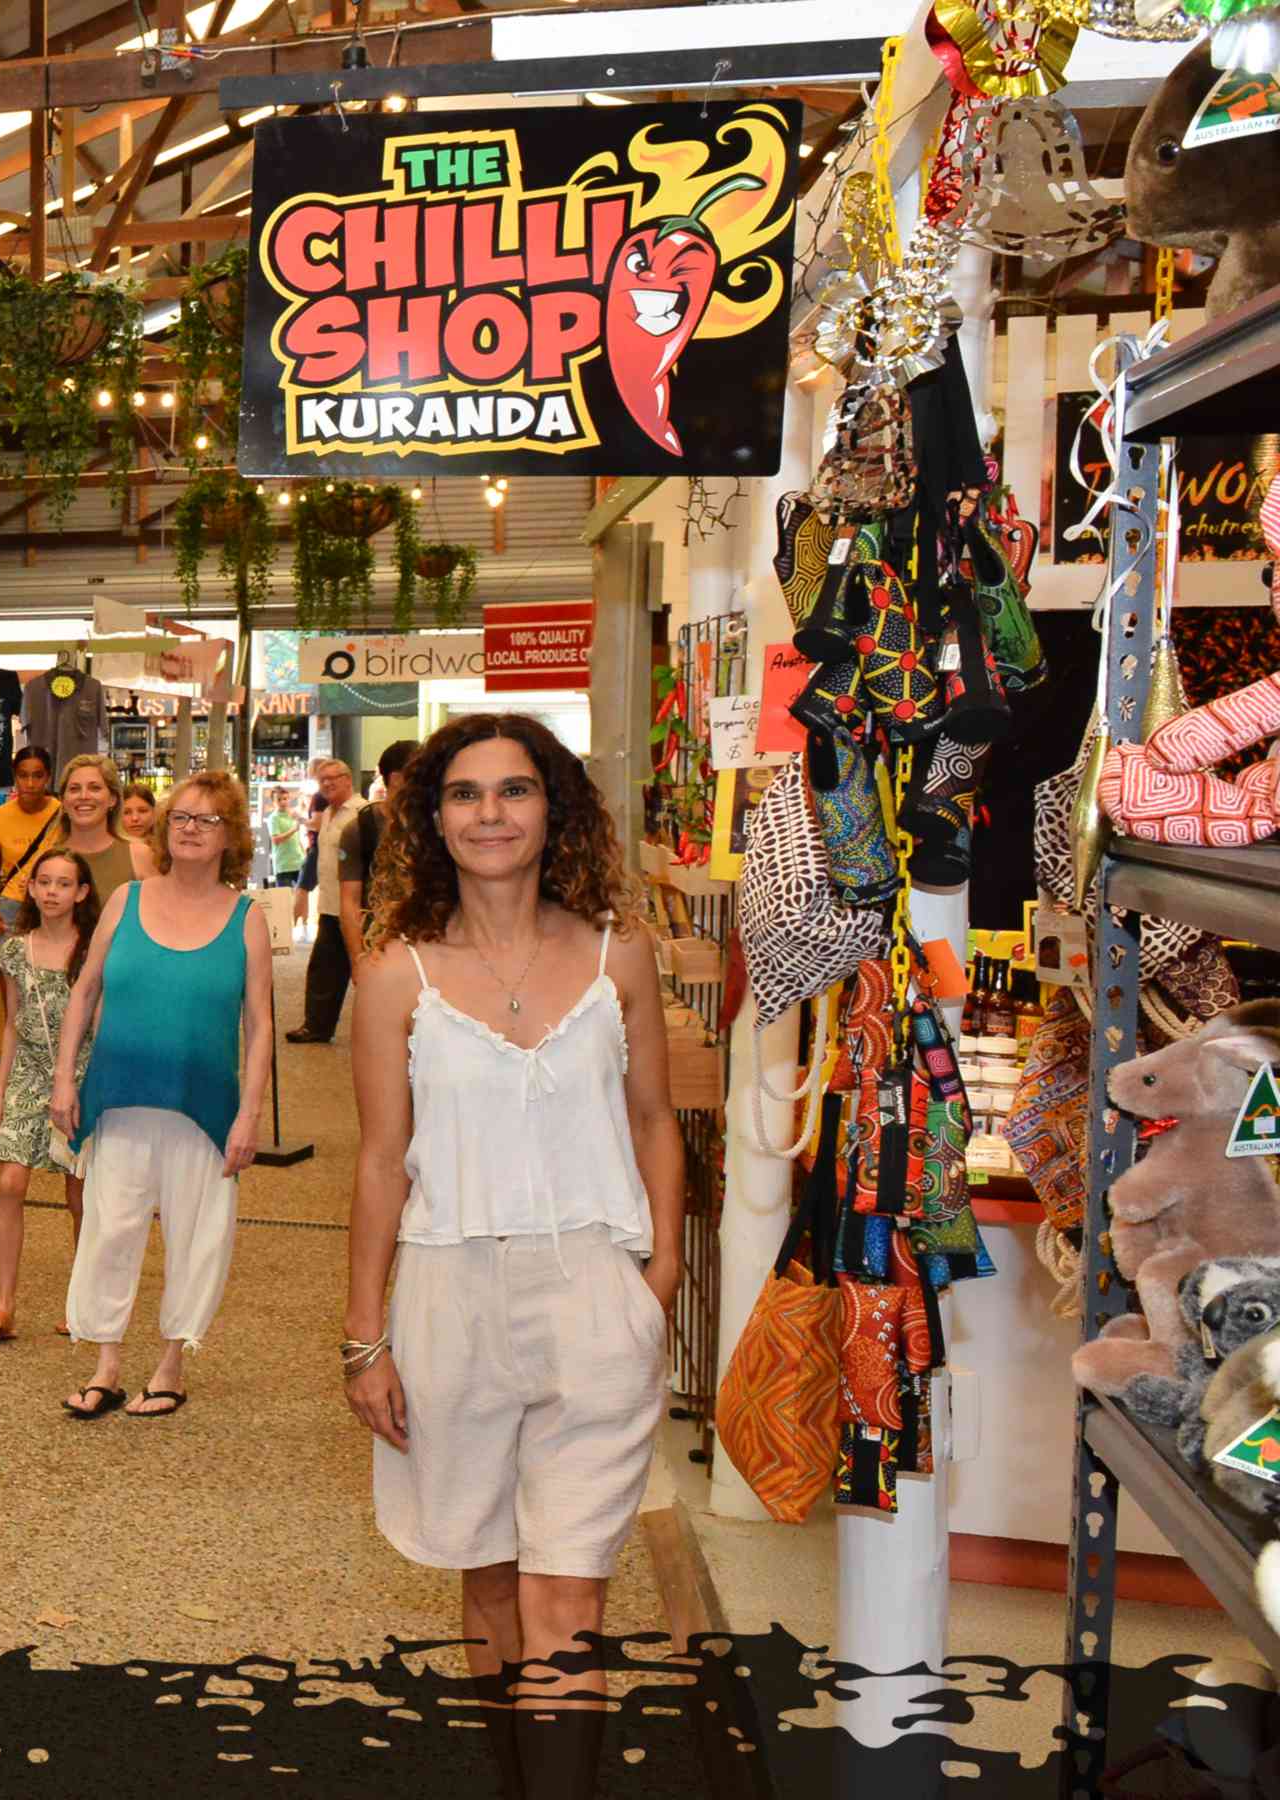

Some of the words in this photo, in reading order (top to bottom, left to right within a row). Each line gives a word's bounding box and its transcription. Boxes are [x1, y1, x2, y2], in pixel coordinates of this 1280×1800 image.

[401, 147, 503, 188] THE
[274, 199, 625, 292] CHILLI
[285, 291, 601, 382] SHOP
[302, 395, 577, 438] KURANDA
[486, 650, 523, 667] LOCAL
[524, 648, 578, 665] PRODUCE
[510, 631, 537, 646] 100%
[538, 629, 585, 645] QUALITY
